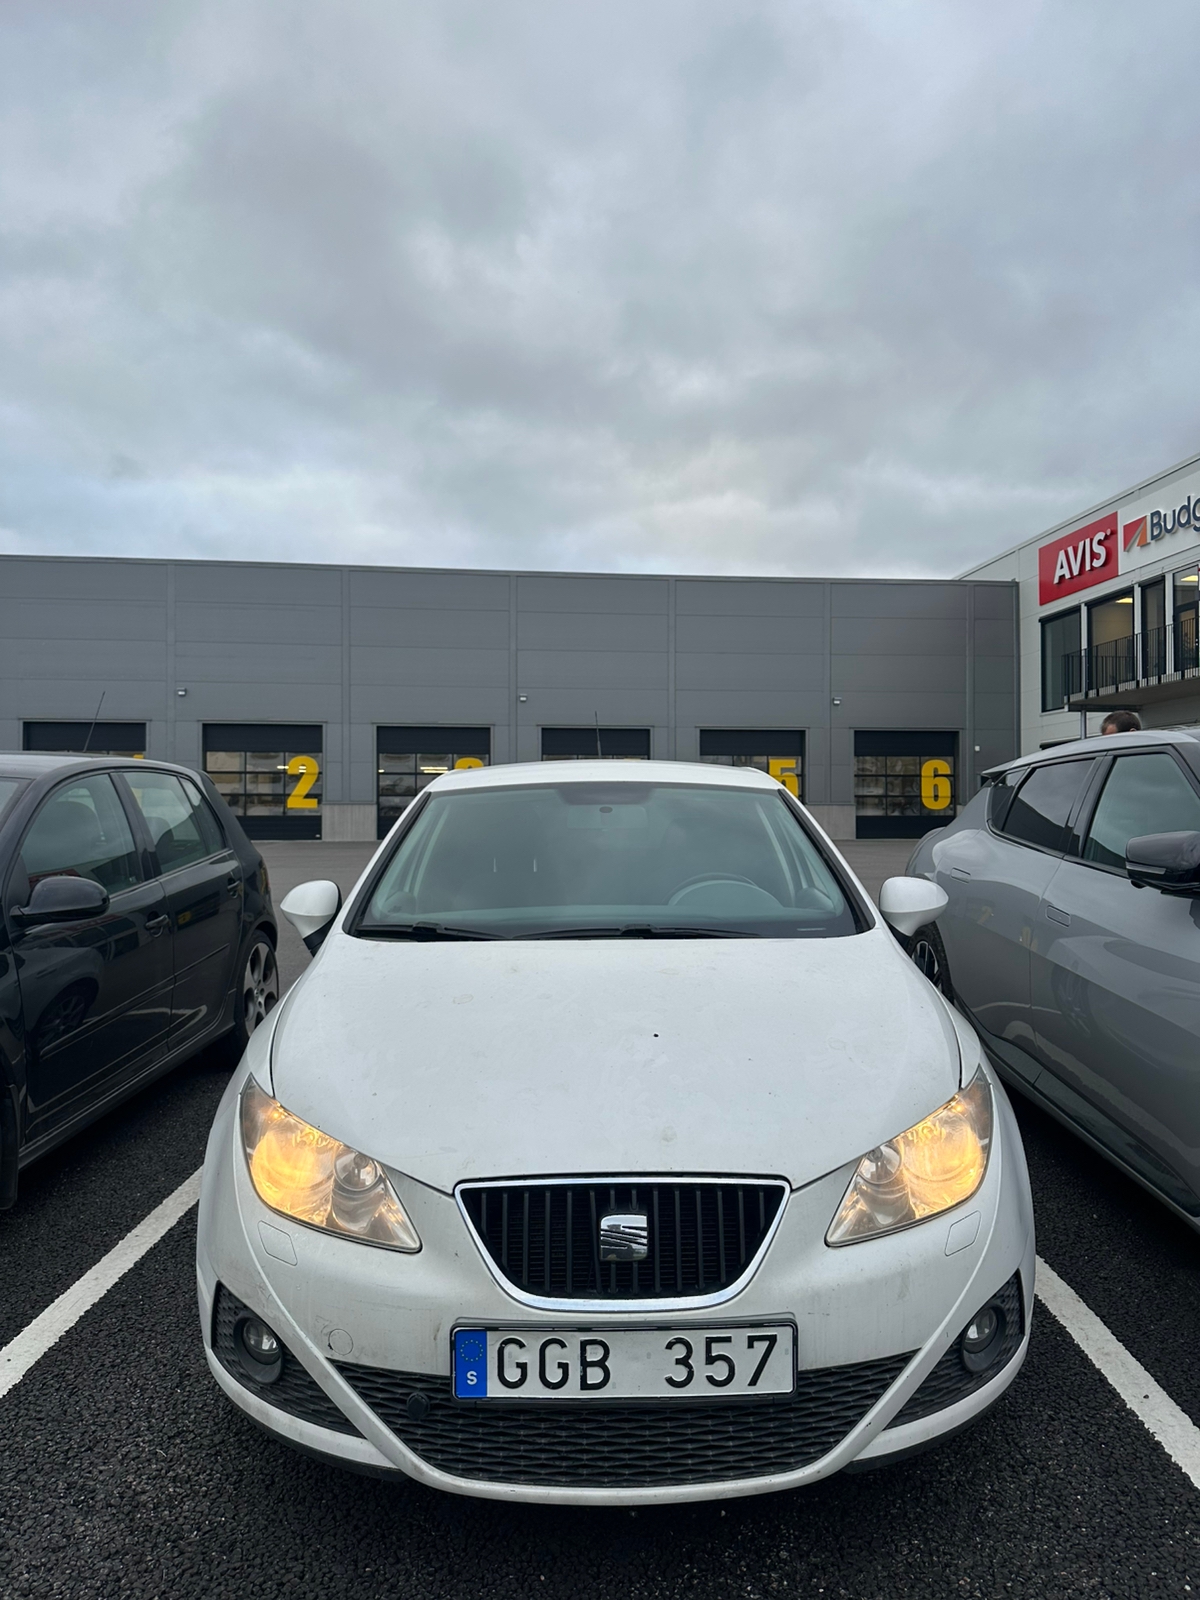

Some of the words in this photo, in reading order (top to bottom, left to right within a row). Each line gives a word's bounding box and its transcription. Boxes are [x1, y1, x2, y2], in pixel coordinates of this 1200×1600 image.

[1053, 531, 1107, 585] AVIS
[287, 755, 319, 809] 2
[921, 758, 951, 811] 6
[467, 1370, 477, 1385] S
[497, 1337, 611, 1391] GGB
[664, 1334, 778, 1389] 357
